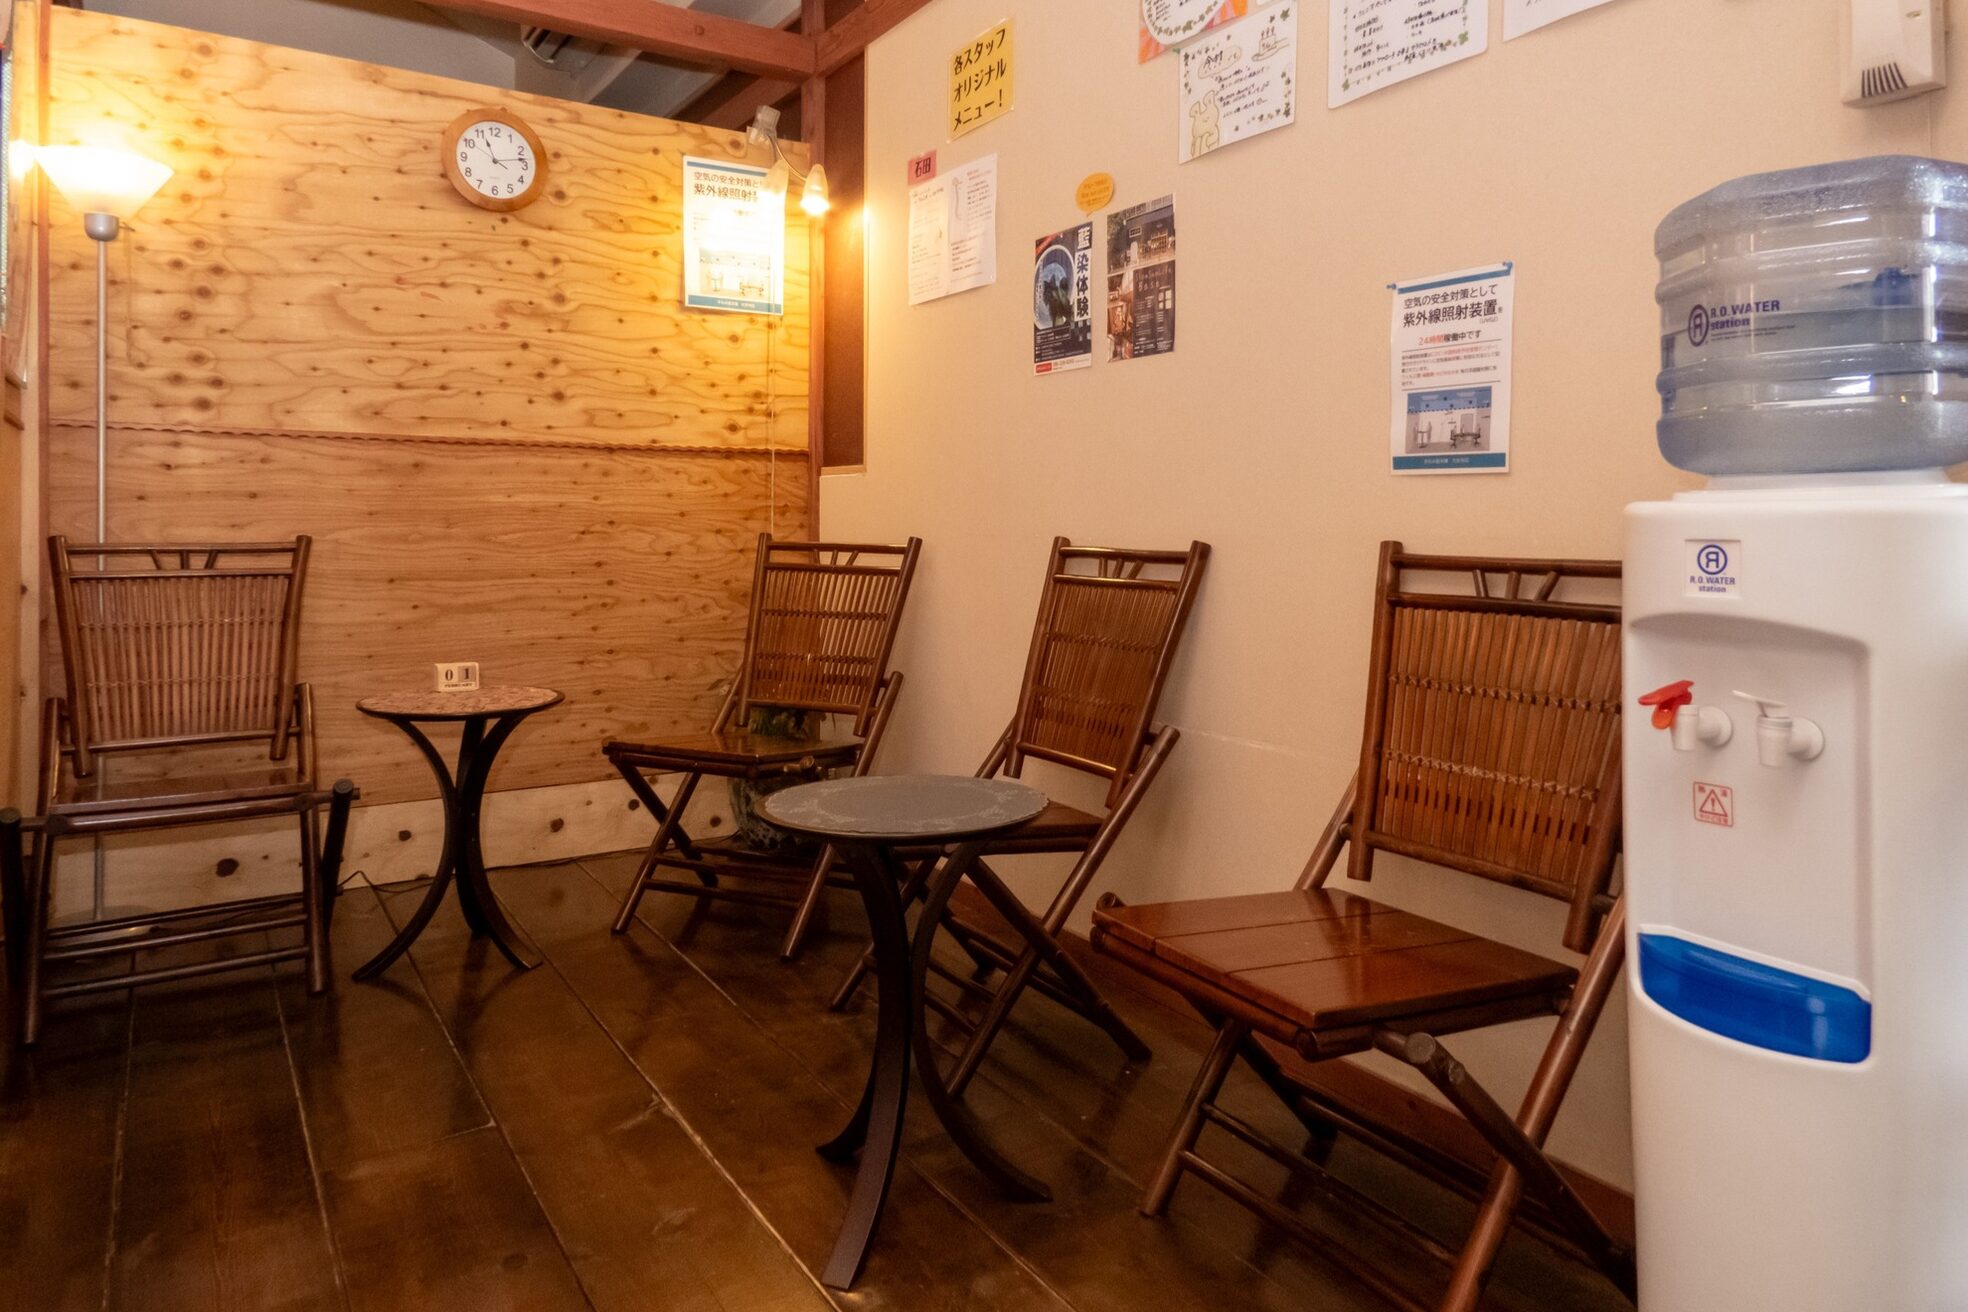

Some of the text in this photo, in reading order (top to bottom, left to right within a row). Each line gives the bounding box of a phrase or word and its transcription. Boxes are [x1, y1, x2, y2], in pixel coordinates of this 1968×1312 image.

[953, 28, 1006, 74] 各スタッフ
[953, 63, 1007, 102] オリジナル
[952, 89, 1004, 132] メニュー！
[475, 129, 484, 139] 11
[488, 127, 501, 138] 12
[463, 138, 475, 149] 10
[508, 134, 513, 143] 1
[517, 146, 524, 155] 2
[460, 152, 467, 162] 9
[521, 161, 528, 170] 3
[915, 156, 931, 178] 石田
[464, 167, 472, 178] 8
[476, 180, 483, 189] 7
[518, 175, 524, 184] 4
[491, 186, 498, 196] 6
[507, 184, 513, 193] 5
[1076, 225, 1091, 318] 藍染体験
[1403, 284, 1499, 309] 空気の安全対策として
[1403, 299, 1498, 328] 紫外線照射装置
[1710, 318, 1750, 330] station
[1698, 585, 1727, 593] station
